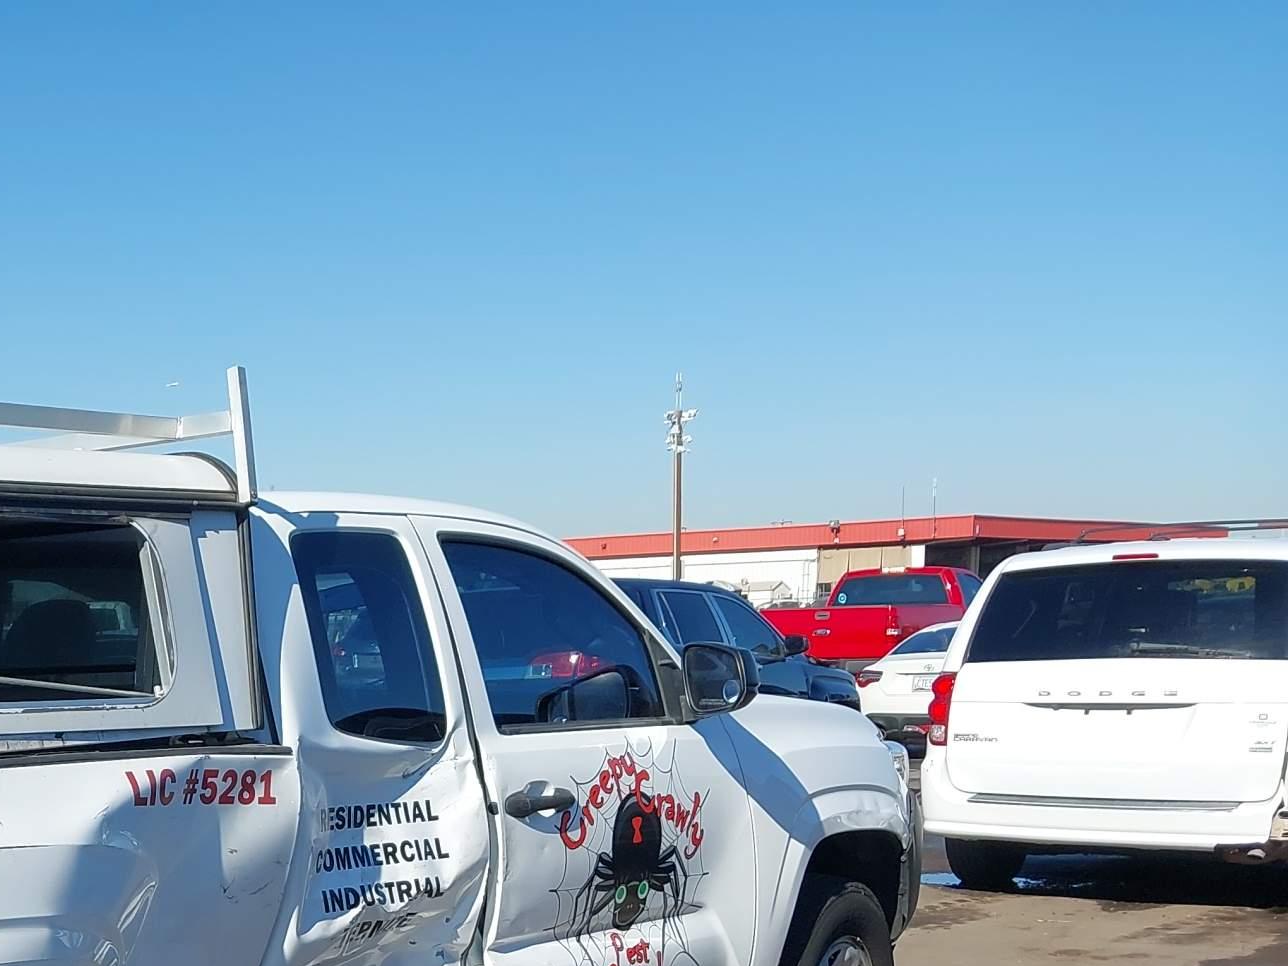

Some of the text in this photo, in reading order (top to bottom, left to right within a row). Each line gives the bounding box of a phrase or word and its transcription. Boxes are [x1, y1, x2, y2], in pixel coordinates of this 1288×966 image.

[125, 768, 277, 806] LIC #5281
[560, 752, 705, 860] Creepy Crawly
[320, 799, 439, 832] RESIDENTIAL
[315, 837, 450, 874] COMMERCIAL
[321, 876, 445, 914] INDUSTRIAL
